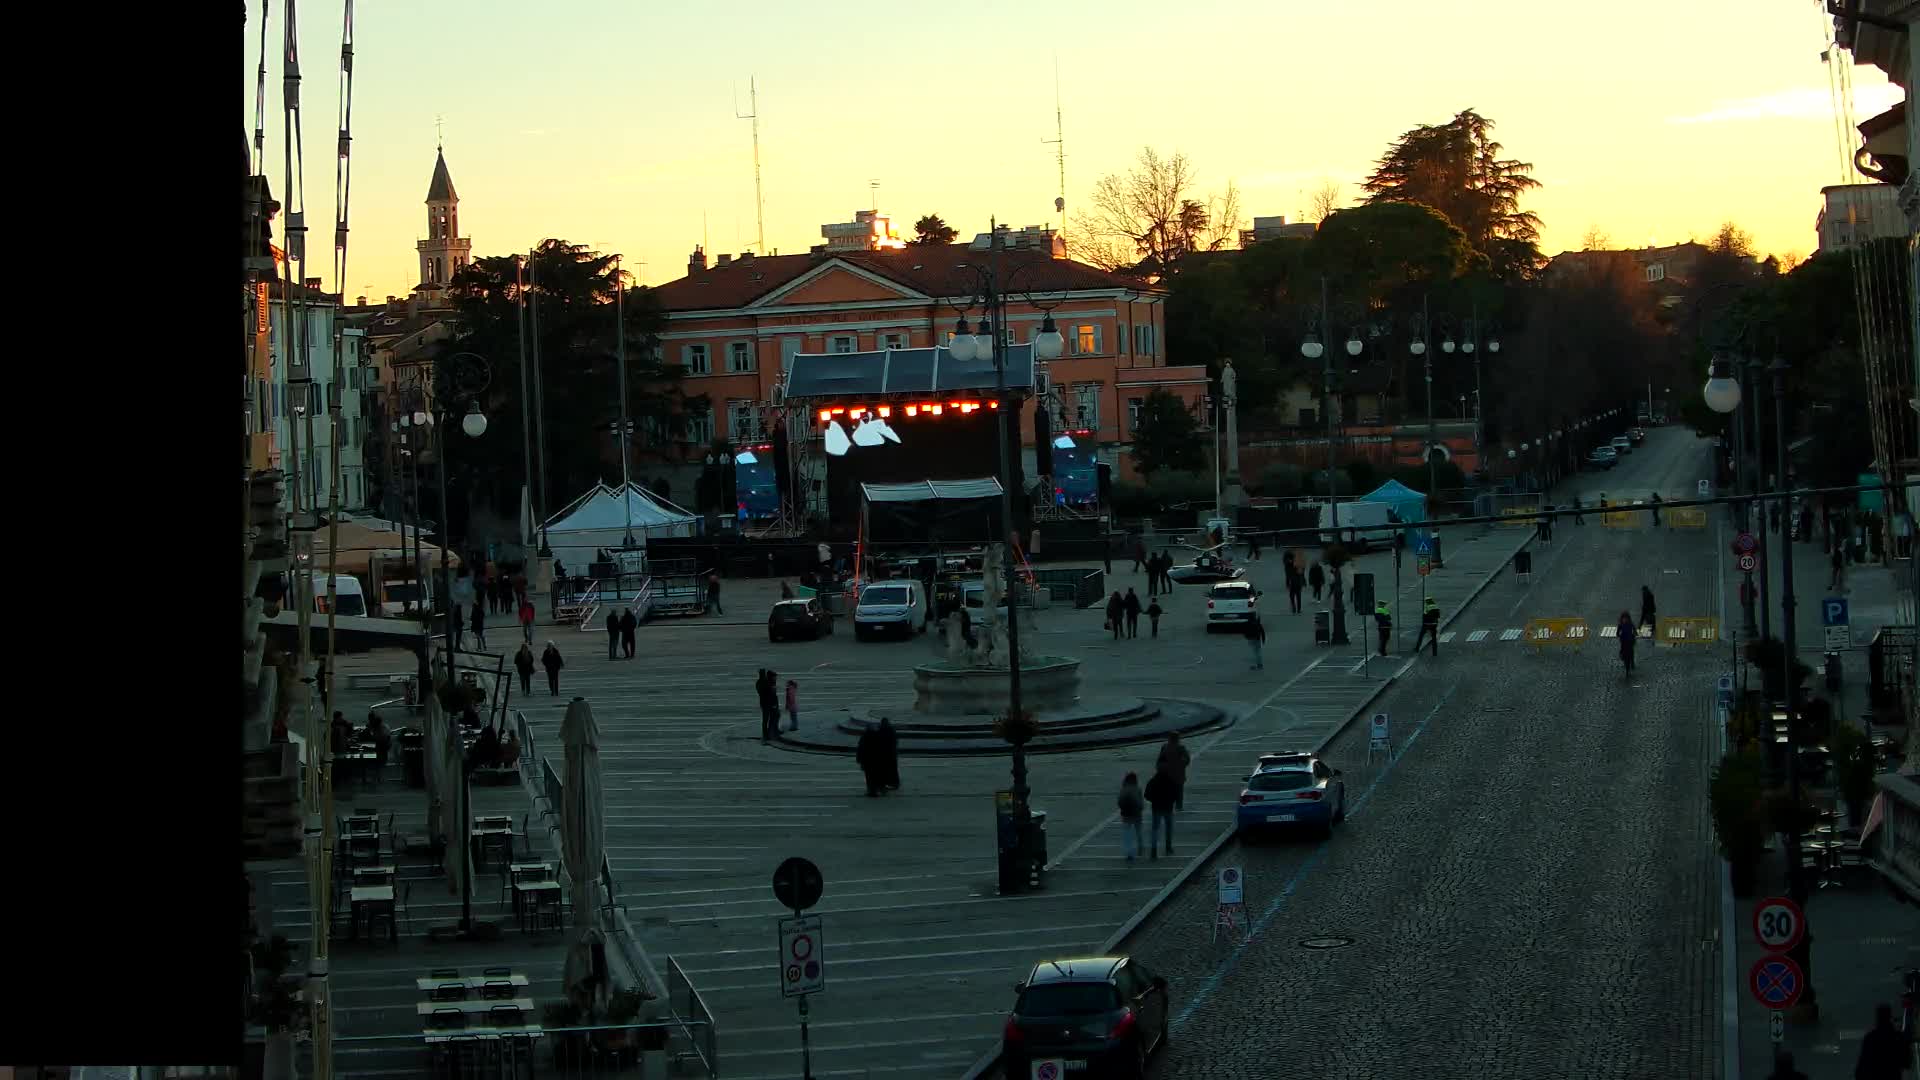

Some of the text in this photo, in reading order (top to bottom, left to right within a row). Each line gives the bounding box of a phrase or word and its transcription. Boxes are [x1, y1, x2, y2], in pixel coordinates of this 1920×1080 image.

[1742, 557, 1753, 568] 20
[1827, 602, 1842, 623] P
[1762, 911, 1791, 938] 30
